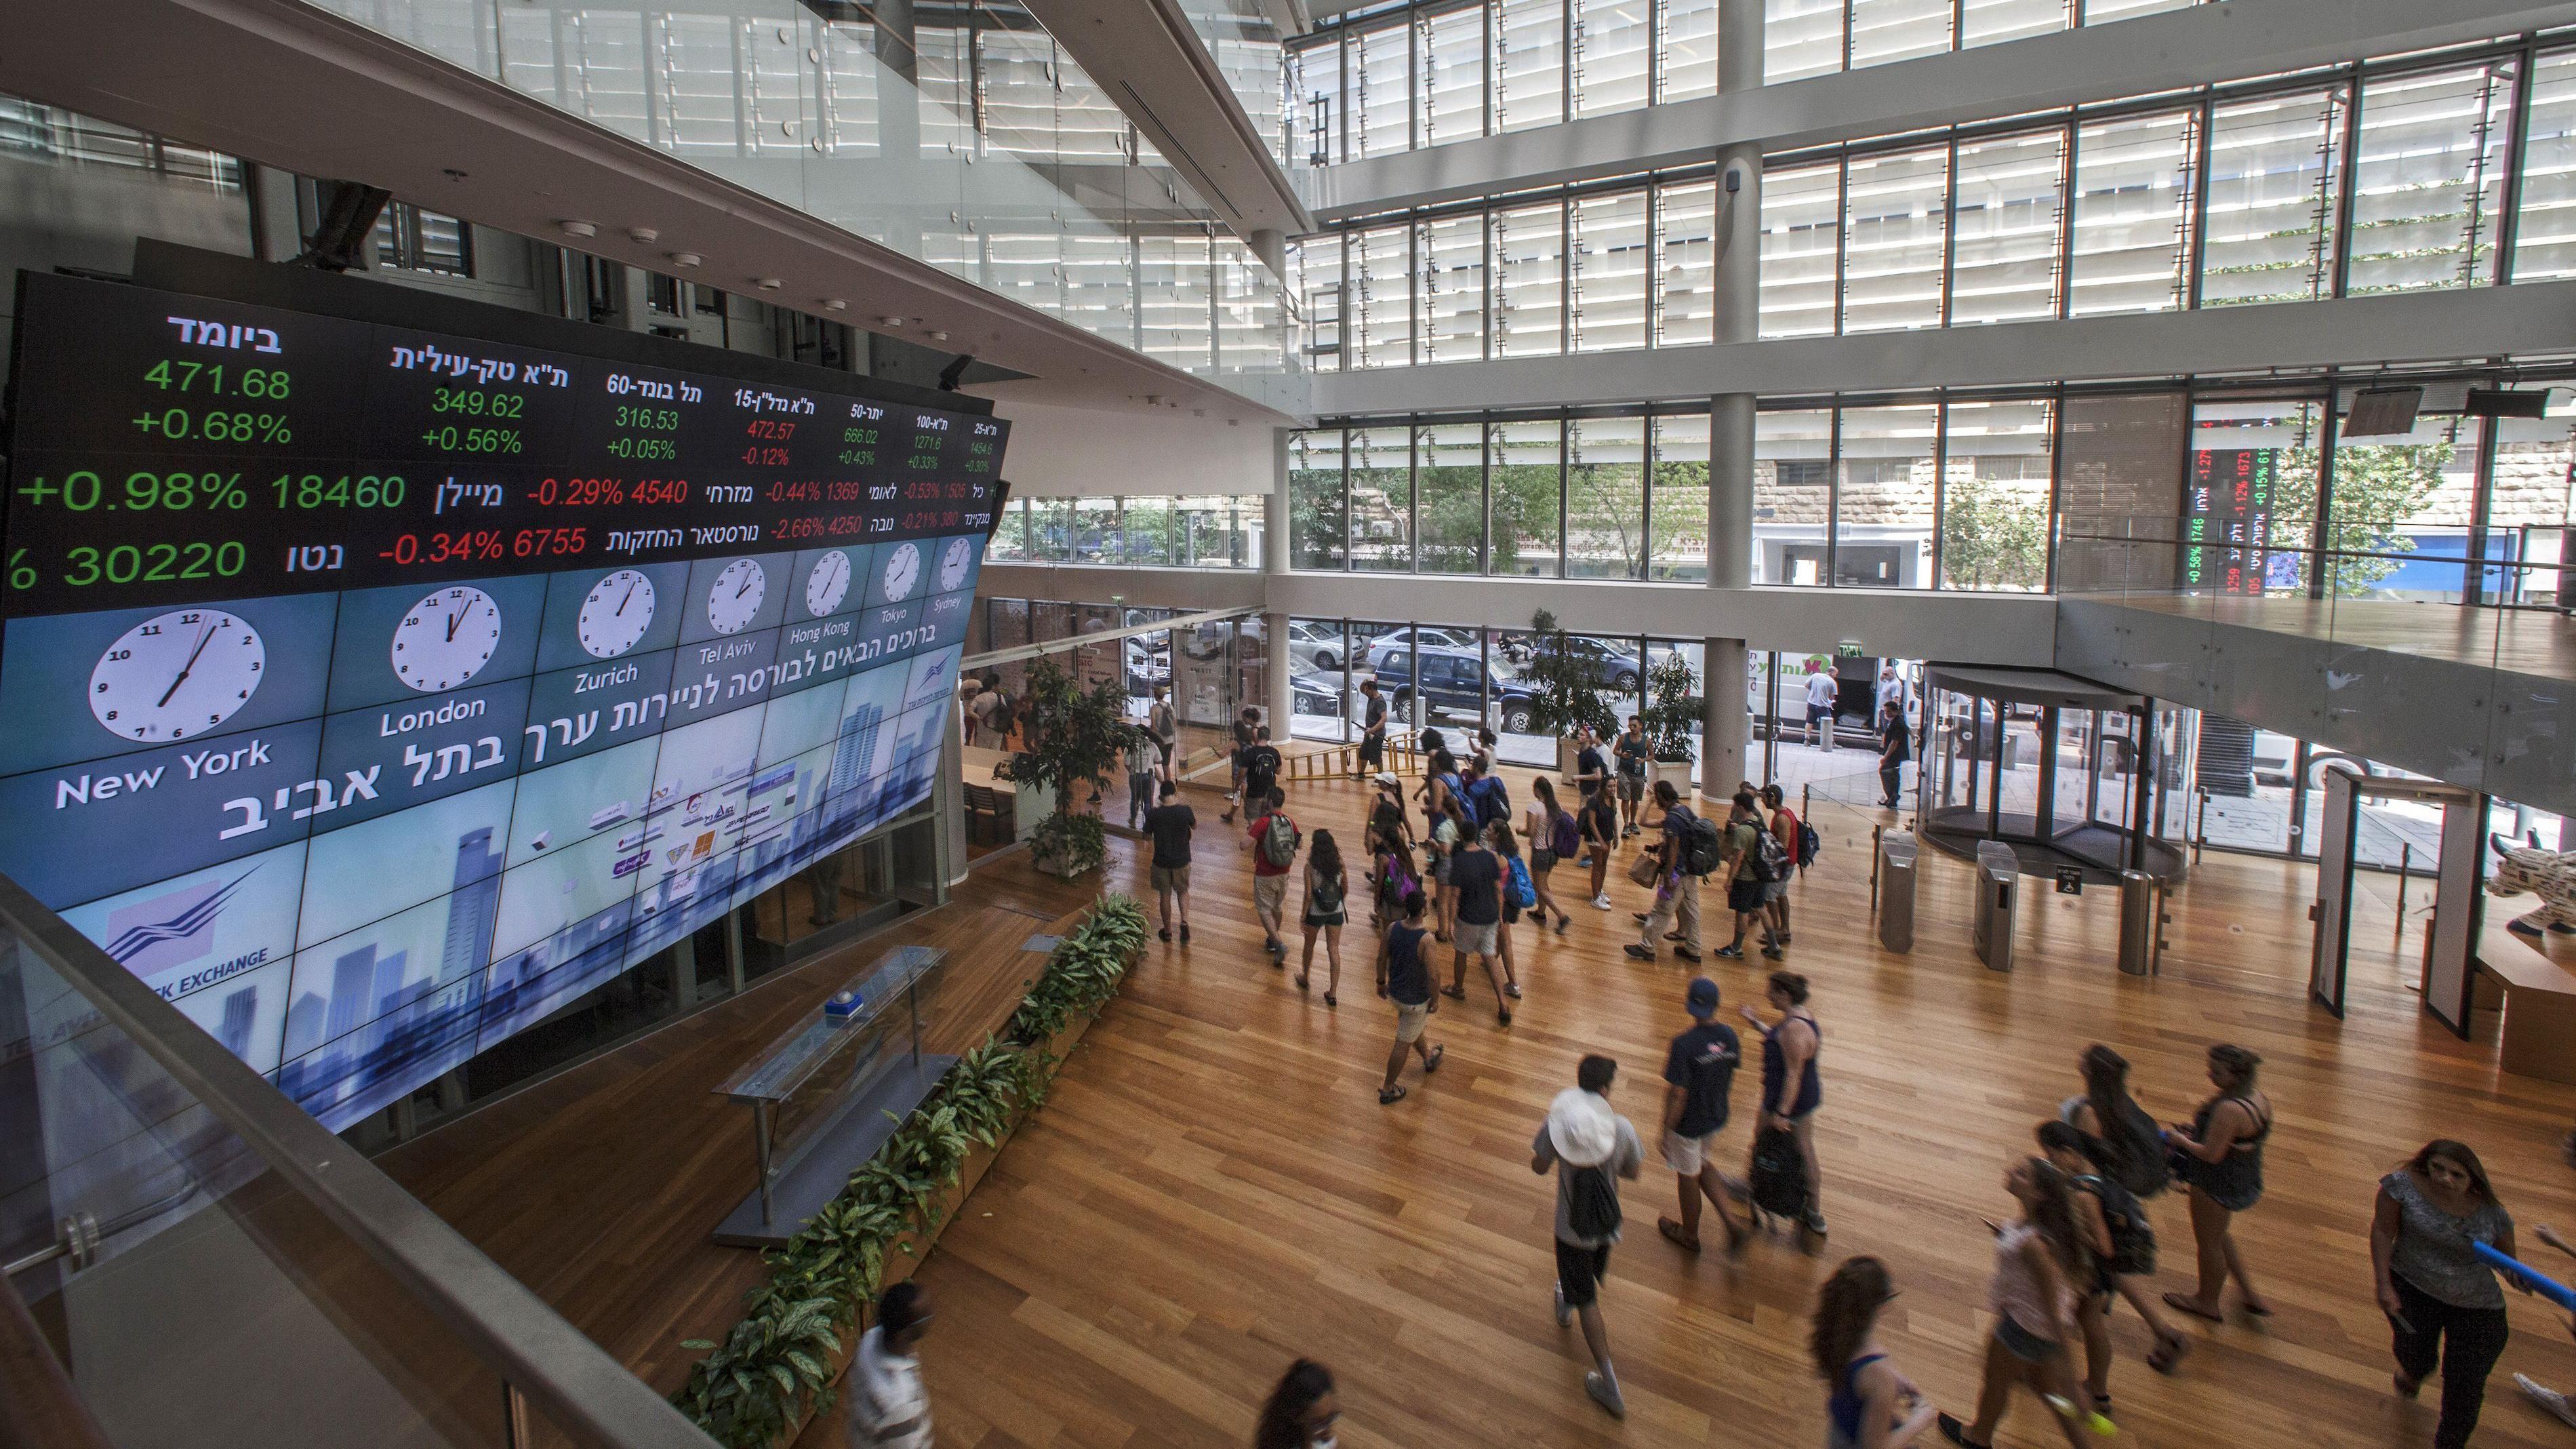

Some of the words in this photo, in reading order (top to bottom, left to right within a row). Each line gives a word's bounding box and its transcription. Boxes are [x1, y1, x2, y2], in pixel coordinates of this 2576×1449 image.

[167, 316, 282, 354] ביומד
[389, 344, 517, 384] טק-עילית
[144, 359, 290, 399] 471.68
[523, 363, 569, 387] ת"א
[606, 374, 674, 400] בונד-60
[680, 380, 703, 403] תל
[432, 387, 525, 418] 349.62
[735, 389, 788, 413] נדל"ן-15
[791, 397, 815, 415] ת"א
[616, 406, 679, 430] 316.53
[851, 403, 883, 420] יתר-50
[132, 408, 291, 443] +0.68%
[747, 420, 795, 439] 472.57
[917, 414, 948, 431] ת"א-100
[974, 422, 997, 436] ת"א-25
[422, 426, 521, 454] +0.56%
[844, 427, 879, 444] 666.02
[914, 435, 942, 450] 1271.6
[607, 437, 675, 460] +0.05%
[742, 447, 789, 466] -0.12%
[839, 450, 874, 466] +0.43%
[971, 441, 993, 455] 1454.6
[908, 455, 938, 470] +0.33%
[17, 471, 247, 511] +0.98%
[272, 475, 405, 509] 18460
[434, 477, 502, 515] מיילן
[527, 478, 623, 505] -0.29%
[631, 479, 687, 504] 4540
[706, 485, 754, 503] מזרחי
[766, 481, 820, 502] -0.44%
[827, 481, 860, 501] 1369
[869, 482, 897, 500] לאומי
[904, 481, 940, 499] -0.53%
[973, 483, 984, 498] כיל
[2254, 467, 2269, 506] +0.15%
[2235, 481, 2249, 517] -1.12%
[771, 517, 824, 539] -2.66%
[828, 515, 862, 535] 4250
[870, 517, 894, 532] נובה
[902, 511, 937, 530] -0.21%
[940, 511, 959, 528] 380
[965, 512, 990, 528] מנקיינד
[690, 524, 759, 544] נורסטאר
[2191, 518, 2205, 542] 1746
[2229, 523, 2245, 542] דלק
[379, 530, 503, 565] -0.34%
[514, 528, 586, 557] 6755
[605, 528, 683, 555] החזקות
[64, 541, 246, 586] 30220
[287, 544, 344, 572] נטו
[2189, 547, 2202, 584] +0.58%
[2250, 550, 2261, 570] סיטי
[2227, 568, 2240, 593] 3259
[2248, 577, 2260, 595] 105
[450, 590, 462, 598] 12
[934, 595, 961, 613] Sydney
[180, 614, 199, 624] 12
[221, 618, 230, 627] 1
[405, 618, 418, 626] 10
[881, 608, 907, 624] Tokyo
[140, 624, 161, 636] 11
[790, 625, 820, 645] Hong
[823, 620, 851, 637] Kong
[886, 624, 936, 652] ברוכים
[243, 636, 252, 646] 2
[397, 643, 403, 651] 9
[108, 650, 131, 661] 10
[699, 646, 721, 664] Tel
[725, 639, 757, 660] Aviv
[822, 639, 881, 673] הבאים
[251, 662, 260, 671] 3
[727, 651, 816, 699] לבורסה
[574, 662, 639, 694] Zurich
[98, 683, 108, 694] 9
[239, 690, 247, 699] 4
[609, 673, 721, 732] לניירות
[106, 711, 117, 721] 8
[209, 715, 220, 723] 5
[380, 699, 487, 738] London
[135, 728, 146, 737] 7
[173, 728, 182, 738] 6
[525, 709, 599, 763] ערך
[404, 736, 506, 787] בתל
[56, 766, 165, 810] New
[181, 739, 272, 780] York
[220, 764, 381, 841] אביב
[179, 947, 268, 993] EXCHANGE
